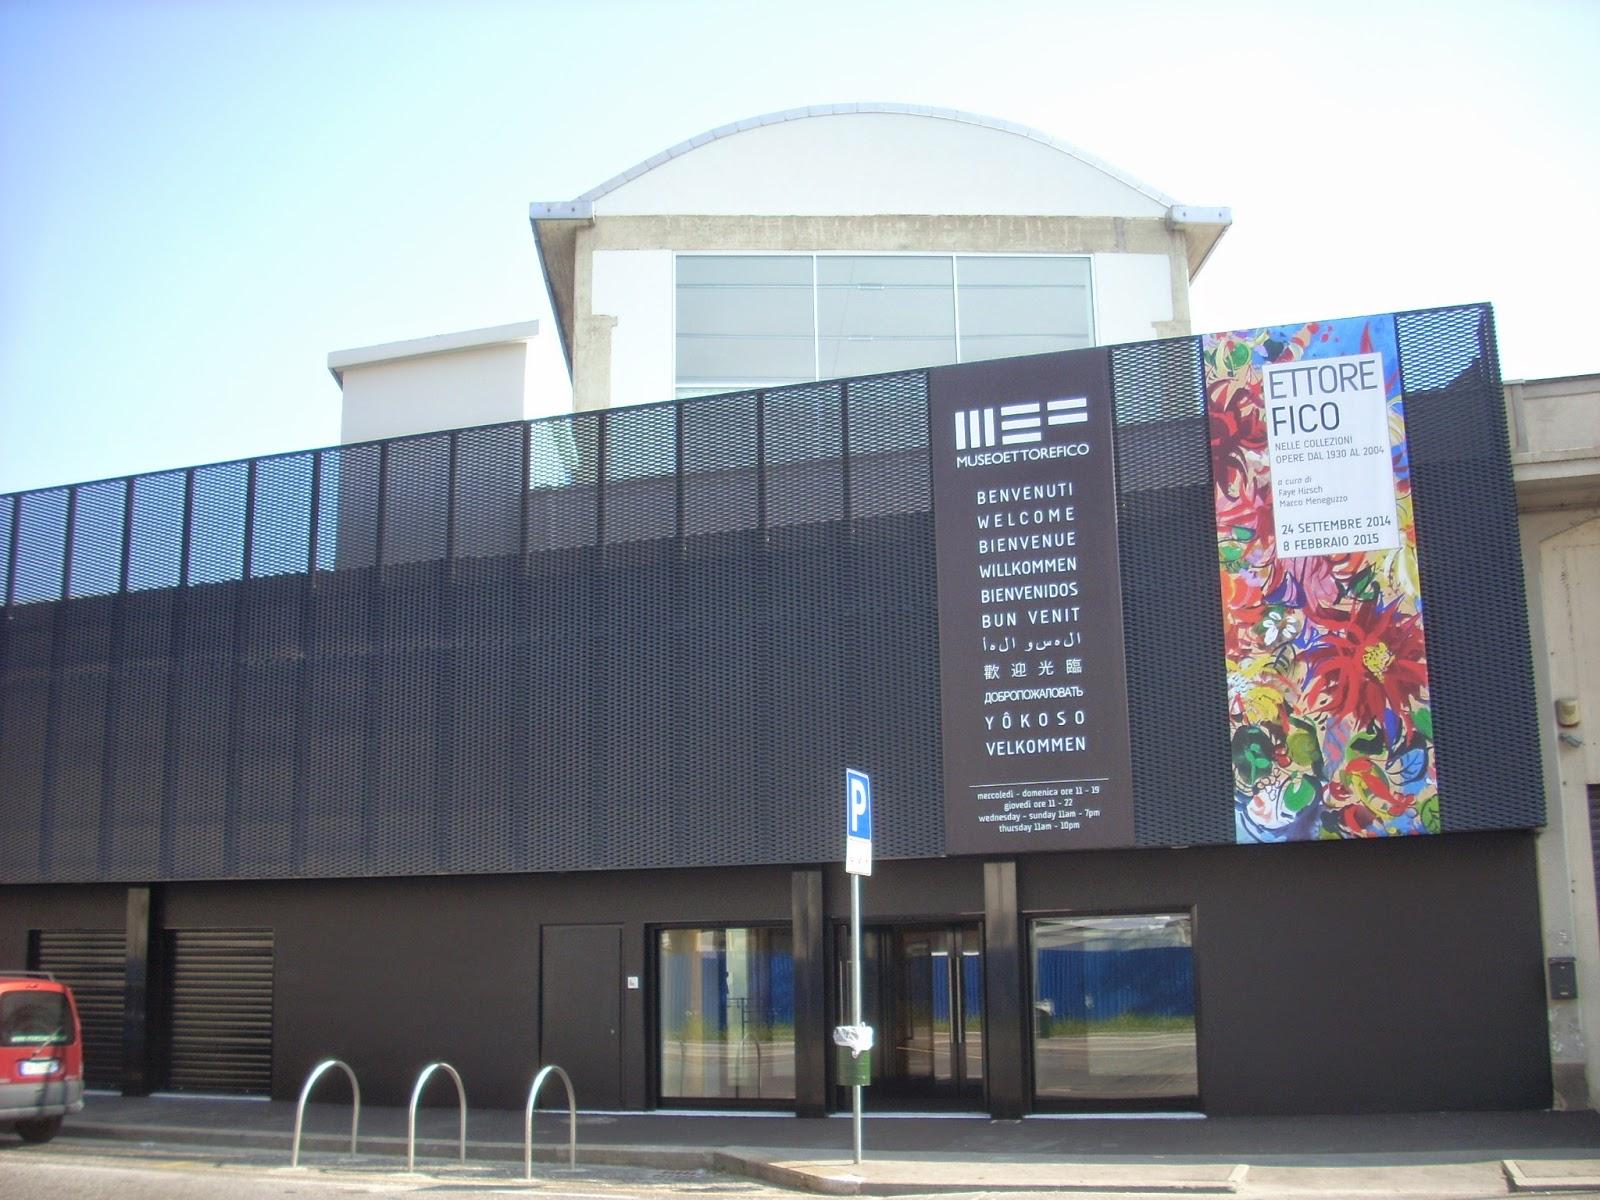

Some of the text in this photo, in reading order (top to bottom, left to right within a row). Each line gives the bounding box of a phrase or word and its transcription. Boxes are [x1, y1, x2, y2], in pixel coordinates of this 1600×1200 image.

[1268, 360, 1378, 400] ETTORE
[1272, 401, 1340, 437] FICO
[1275, 436, 1352, 452] NELLE COLLEZIONI
[956, 443, 1090, 468] MUSEOETTOREFICO
[1276, 446, 1384, 464] OPERE DAL 1930 AL 2004
[1285, 478, 1302, 486] cura
[1304, 476, 1312, 484] di
[977, 482, 1073, 505] BENVENUTI
[1278, 485, 1323, 498] Faye Hirsch
[1280, 496, 1348, 508] Marco Meneguzzo
[977, 507, 1075, 530] WELCOME
[1282, 515, 1391, 536] 24 SETTEMBRE 2014
[979, 532, 1076, 554] BIENVENUE
[1283, 532, 1380, 552] 8 FEBBRAIO 2015
[979, 557, 1077, 579] WILLKOMMEN
[981, 582, 1078, 604] BIENVENIDOS
[982, 607, 1080, 629] BUN VENIT
[984, 686, 1084, 705] ДОБРОПОЖАЛОВАТЬ
[986, 737, 1086, 756] VELKOMMEN
[1022, 788, 1058, 798] domenica
[1060, 788, 1073, 796] ore
[1076, 786, 1083, 795] 11
[1091, 786, 1100, 794] 19
[851, 777, 867, 833] P
[1048, 799, 1056, 808] 11
[1064, 798, 1073, 807] 22
[978, 812, 1020, 822] wednesday
[1029, 810, 1056, 820] sunday
[1058, 810, 1076, 819] 11am
[1084, 808, 1100, 818] 7pm
[999, 823, 1032, 833] thursday
[1034, 822, 1052, 831] 11am
[1060, 820, 1080, 831] 10pm
